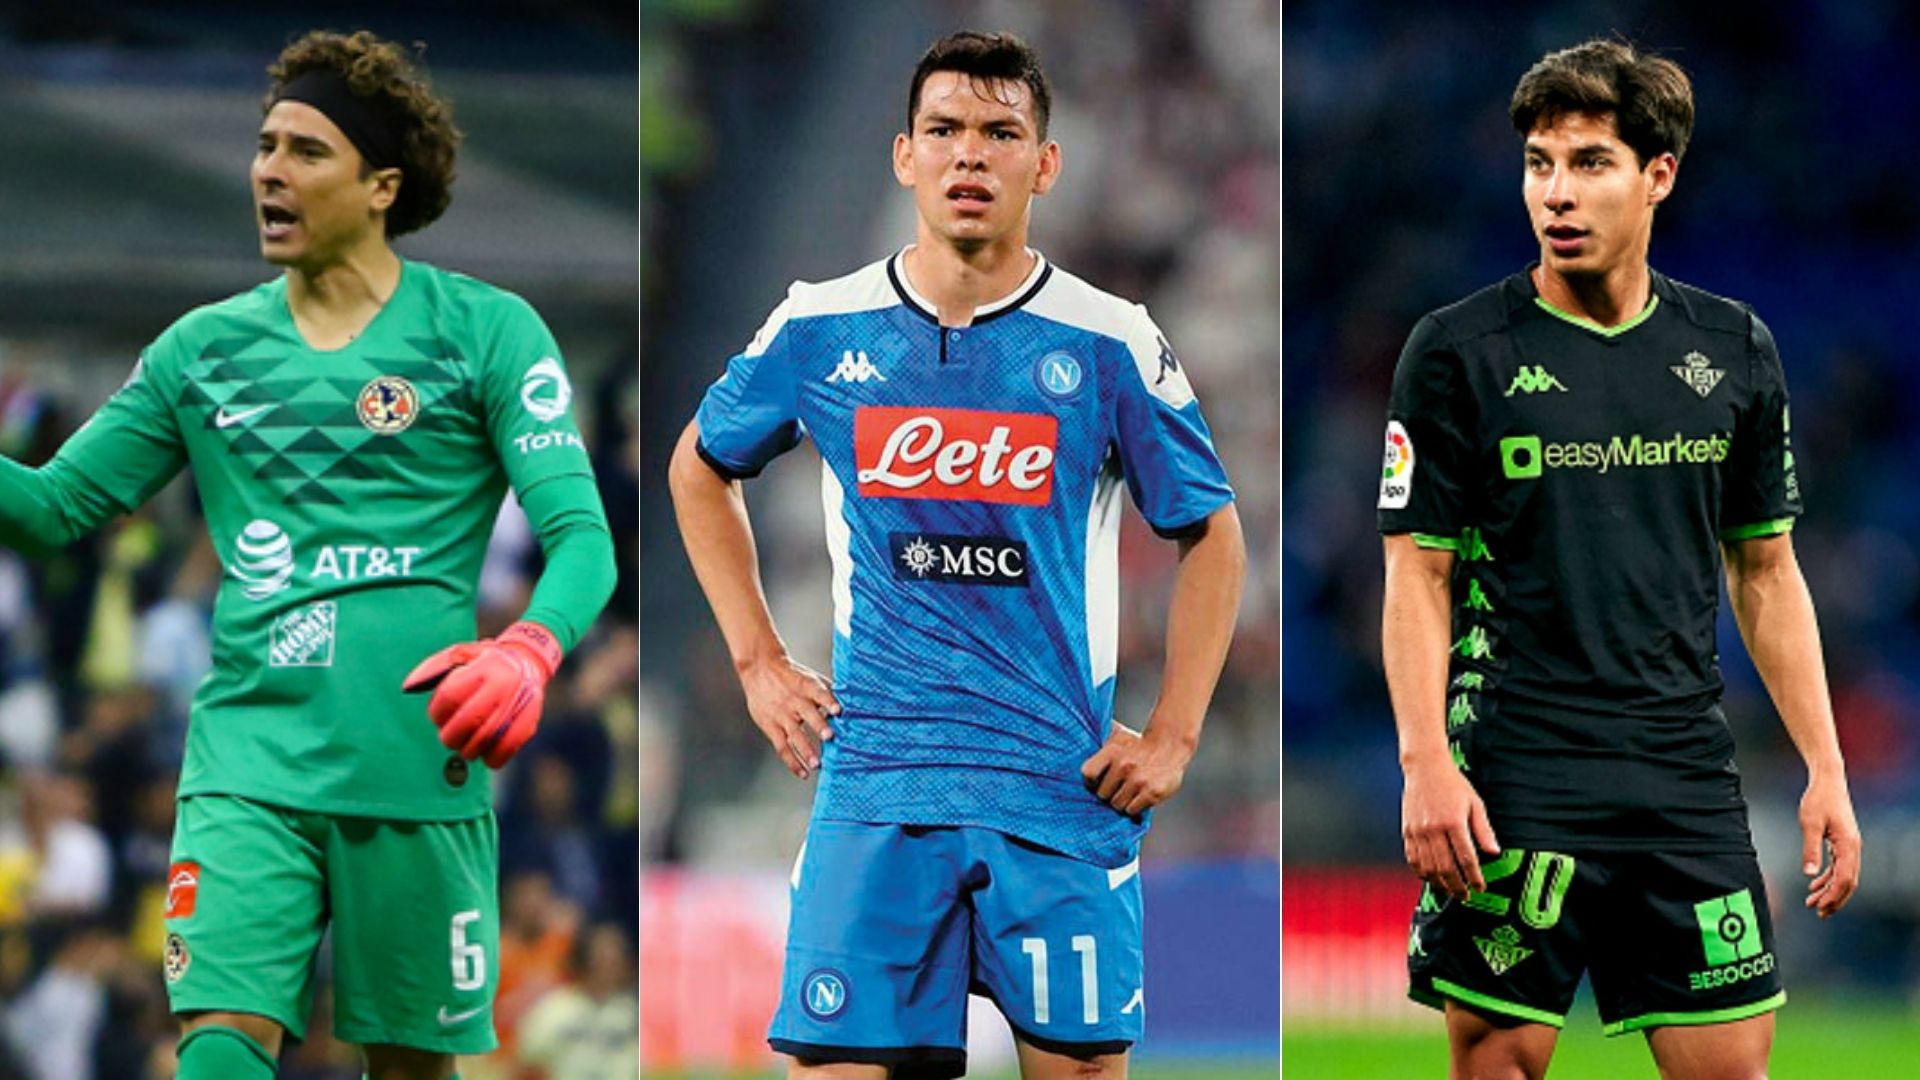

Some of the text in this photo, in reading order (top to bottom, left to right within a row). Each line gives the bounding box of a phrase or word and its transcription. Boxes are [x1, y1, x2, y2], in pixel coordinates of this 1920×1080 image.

[1049, 360, 1073, 386] N
[513, 430, 587, 455] TOTA
[858, 416, 1054, 490] Lete
[1543, 431, 1730, 474] easyMarkets
[310, 545, 422, 581] AT&T
[940, 544, 1024, 577] MSC
[1460, 848, 1575, 929] 20
[449, 909, 487, 992] 6
[813, 980, 838, 1010] N
[1021, 934, 1099, 1025] 11
